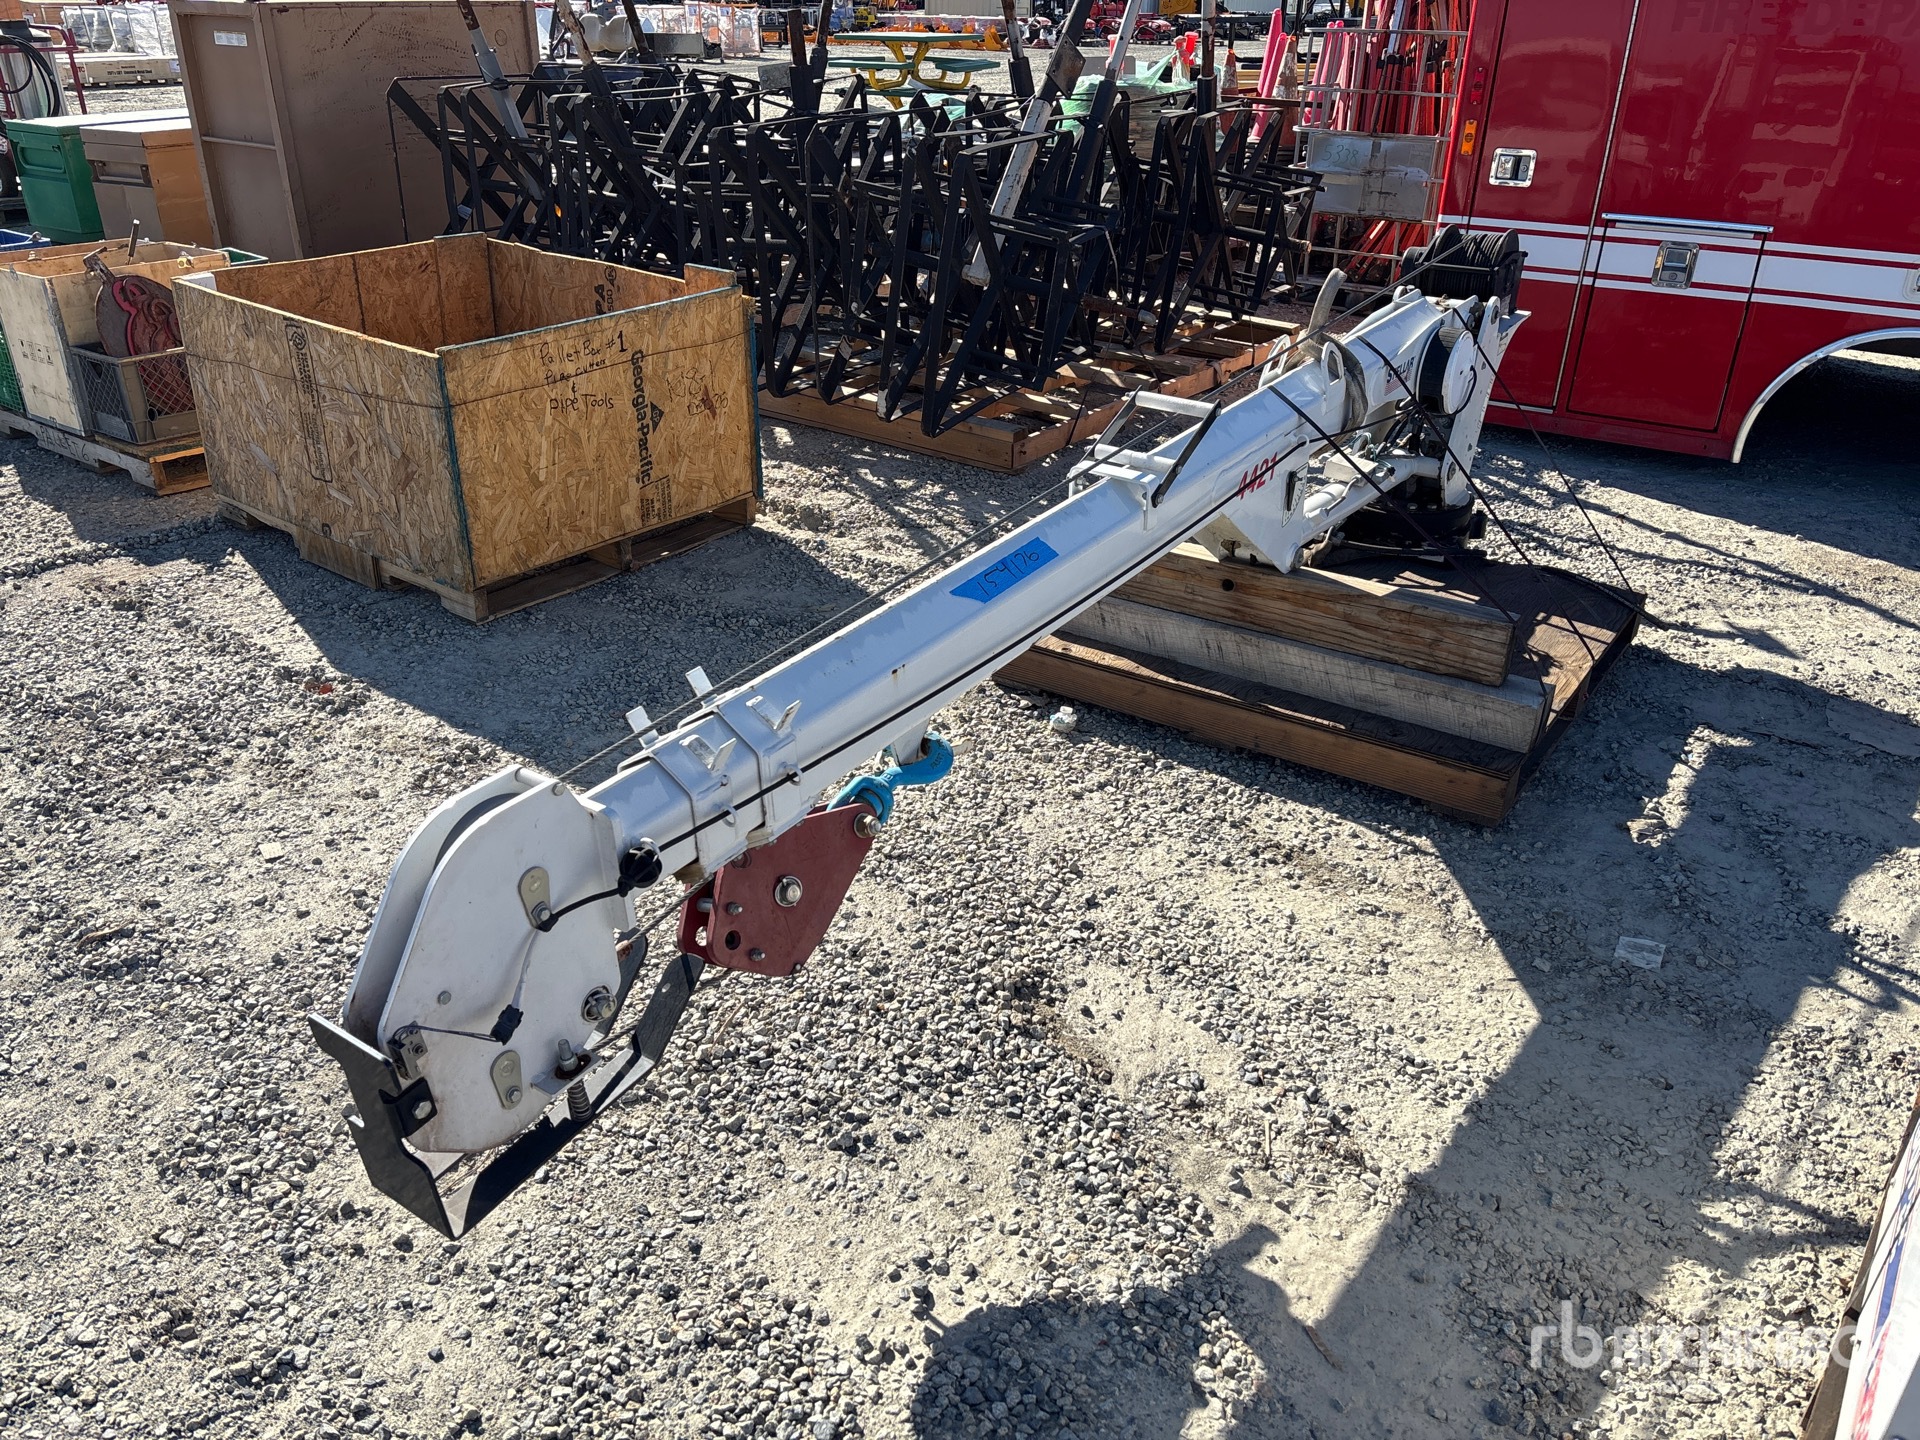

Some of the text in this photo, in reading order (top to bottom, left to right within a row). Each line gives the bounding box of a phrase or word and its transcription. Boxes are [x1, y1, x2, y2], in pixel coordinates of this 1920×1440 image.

[581, 392, 614, 420] Tools
[630, 349, 652, 484] Georgia-Pacific
[1235, 451, 1278, 501] 4421
